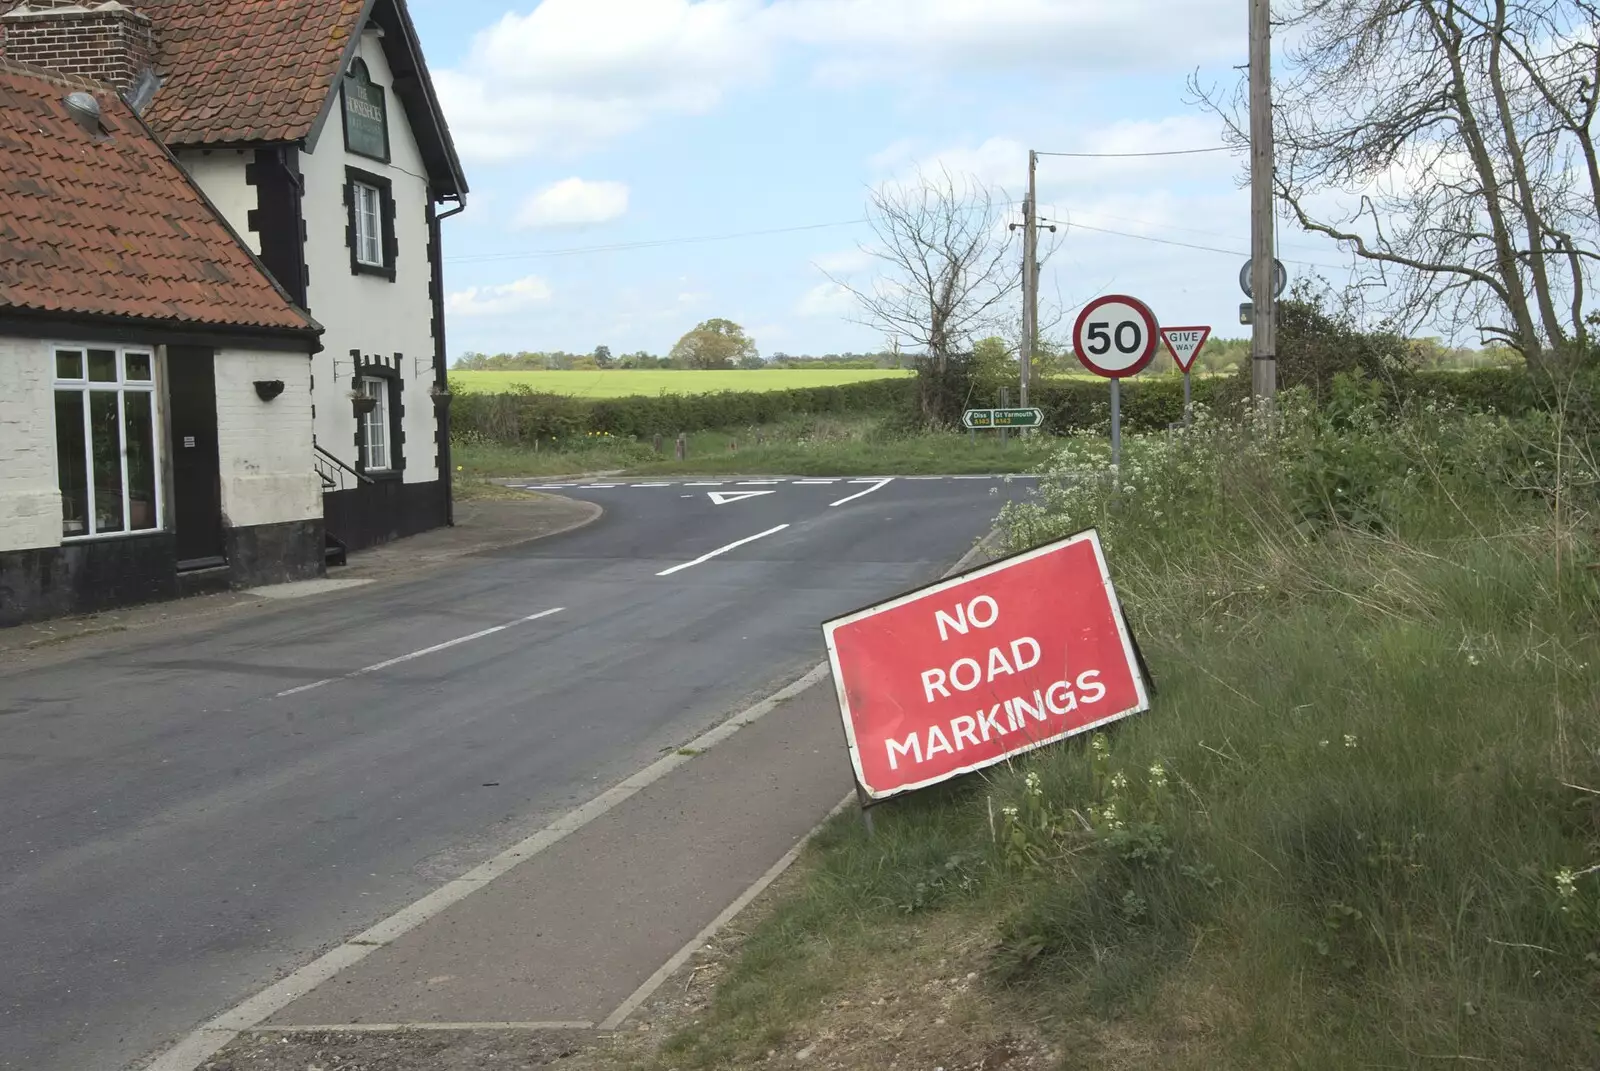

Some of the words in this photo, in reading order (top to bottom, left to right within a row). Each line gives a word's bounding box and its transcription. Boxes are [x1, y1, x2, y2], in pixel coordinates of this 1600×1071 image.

[1087, 320, 1142, 355] 50
[1169, 332, 1199, 342] GIVE
[1175, 343, 1194, 351] WAY
[934, 595, 999, 641] NO
[920, 636, 1041, 704] ROAD
[884, 669, 1106, 771] MARKINGS
